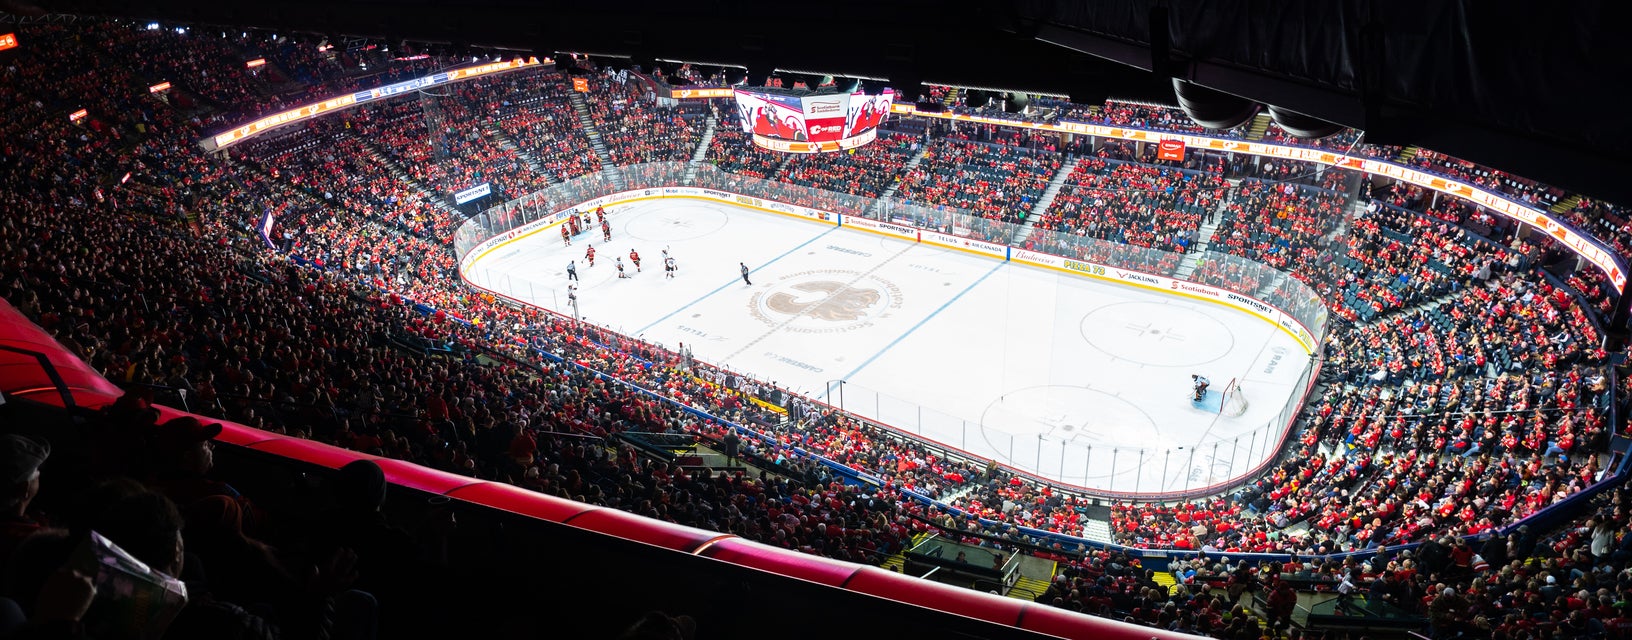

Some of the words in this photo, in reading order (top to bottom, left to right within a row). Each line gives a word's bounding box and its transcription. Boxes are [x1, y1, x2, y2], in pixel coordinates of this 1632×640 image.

[456, 186, 490, 201] SPORTSNET
[704, 190, 731, 198] SPORTSNET
[555, 208, 575, 220] POPEYES
[851, 219, 877, 228] Scotiabank
[879, 223, 914, 235] SPORTSNET
[486, 234, 508, 249] SAFEWAY
[938, 235, 958, 244] TELUS
[980, 243, 1002, 252] CANADA
[1015, 250, 1056, 265] Budweiser
[1063, 259, 1090, 273] PIZZA
[1093, 265, 1106, 276] 73
[1181, 284, 1220, 297] Scotiabank
[1228, 293, 1273, 314] SPORTSNET
[1264, 354, 1282, 375] RAM
